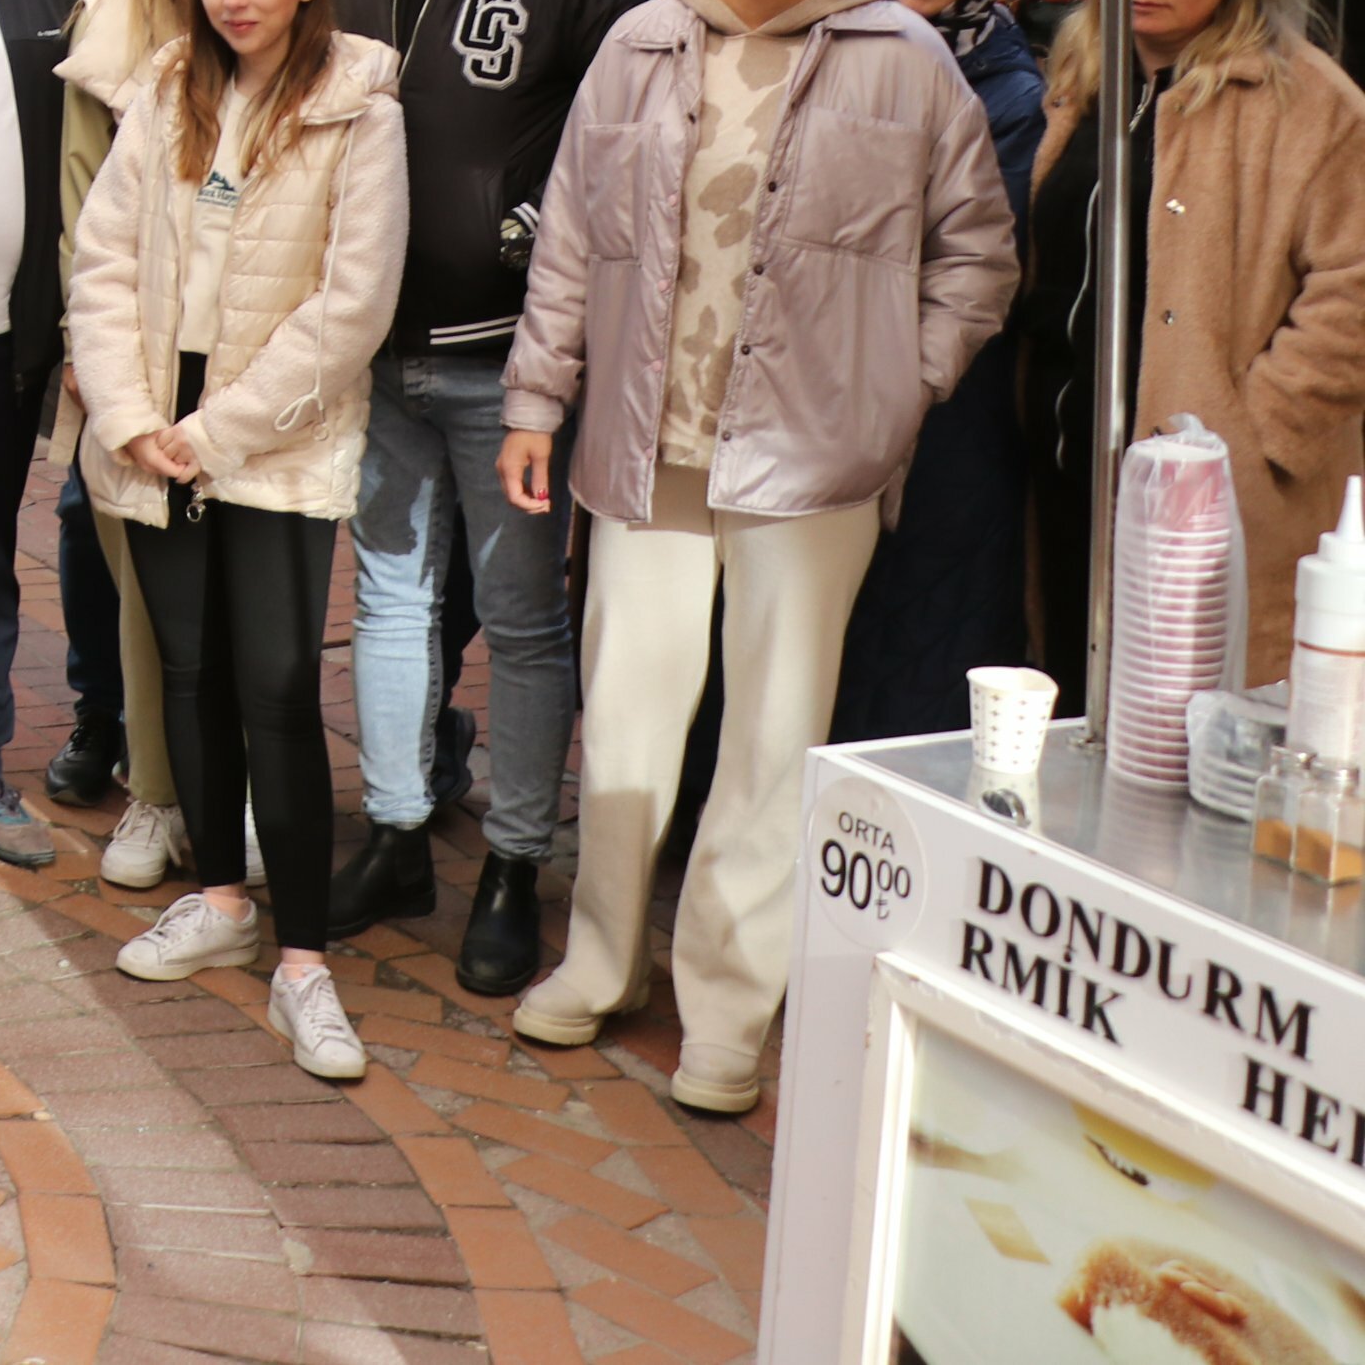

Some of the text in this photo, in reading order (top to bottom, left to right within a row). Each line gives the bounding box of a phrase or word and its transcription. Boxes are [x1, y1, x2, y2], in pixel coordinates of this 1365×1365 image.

[838, 811, 895, 855] ORTA
[958, 918, 1125, 1048] RMİK
[976, 855, 1318, 1063] DONDURM
